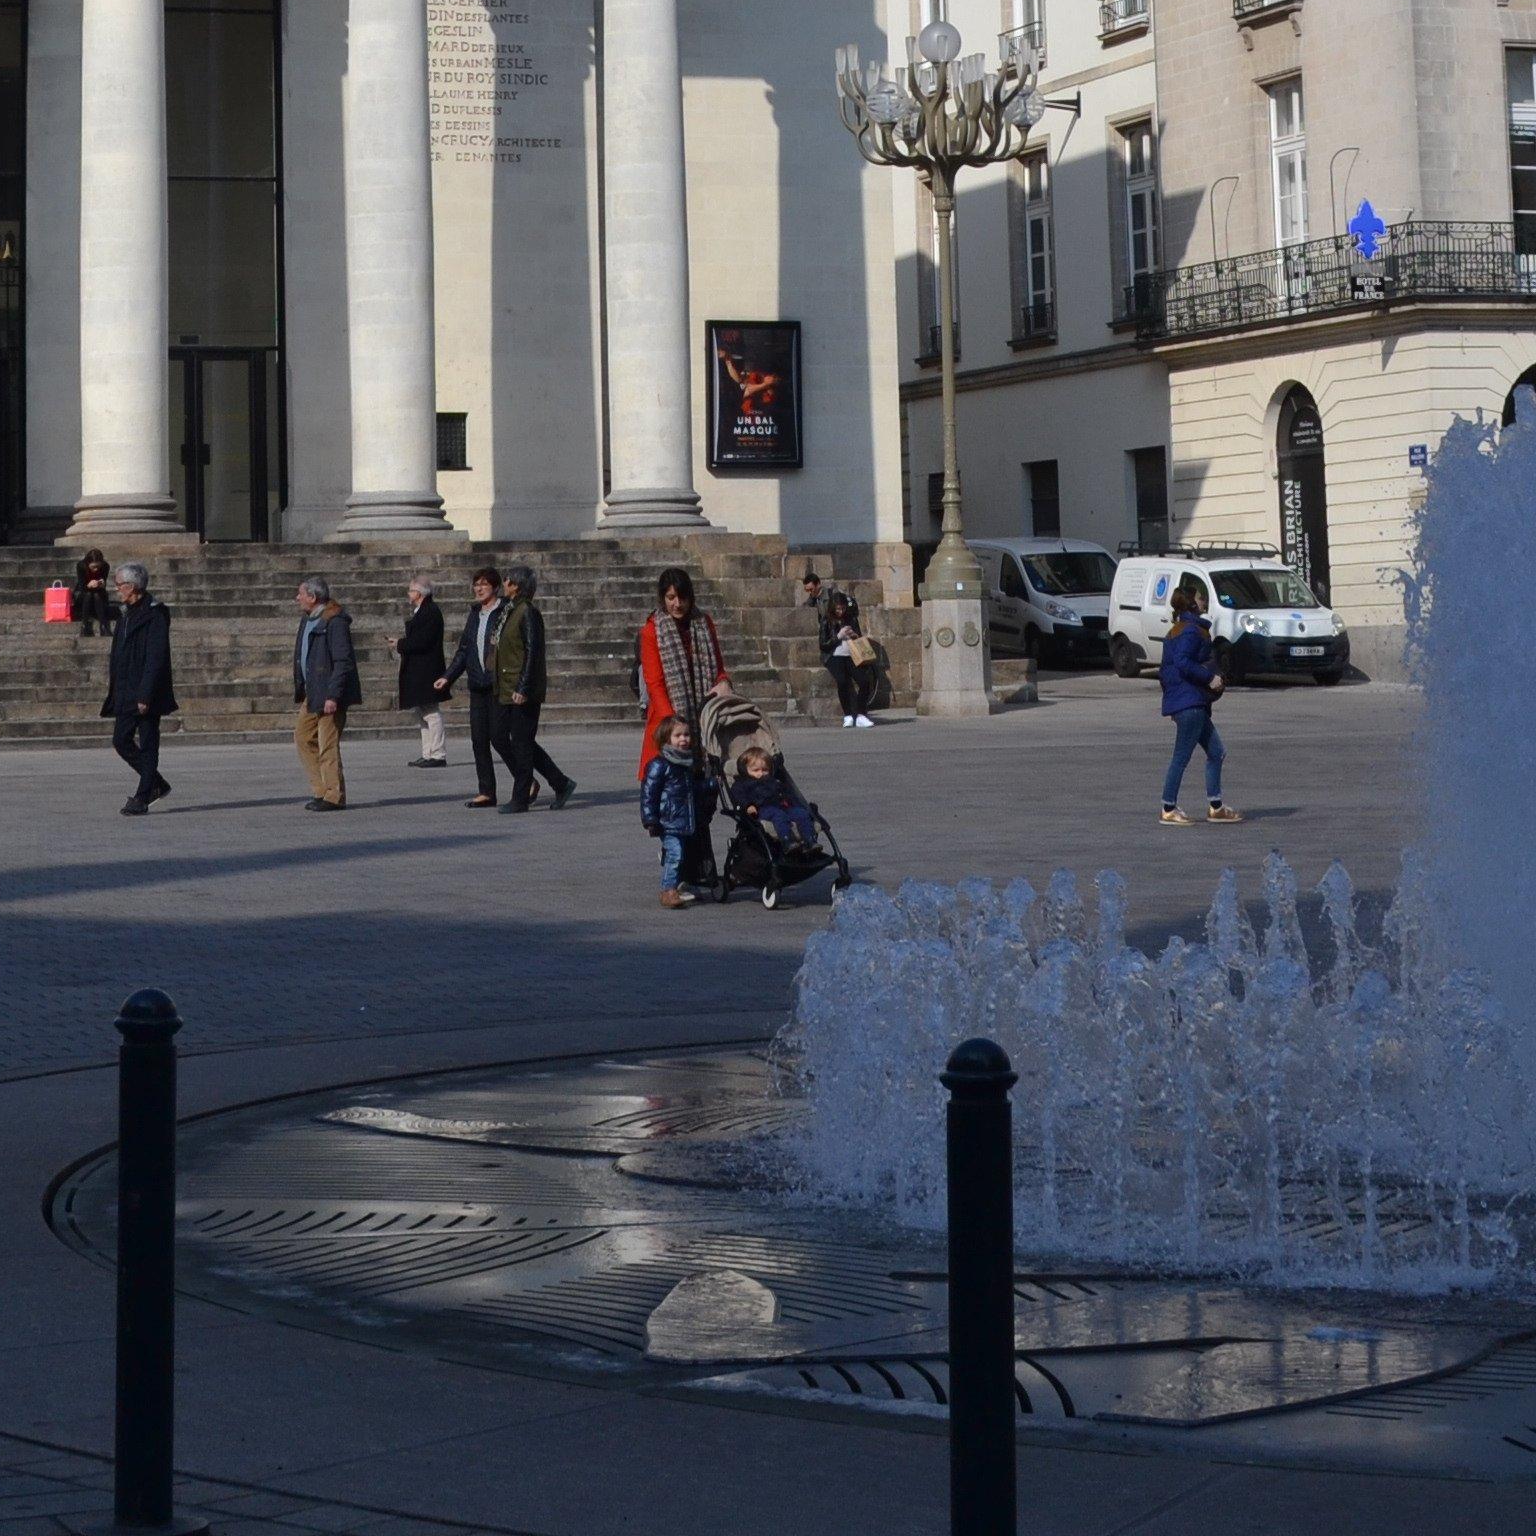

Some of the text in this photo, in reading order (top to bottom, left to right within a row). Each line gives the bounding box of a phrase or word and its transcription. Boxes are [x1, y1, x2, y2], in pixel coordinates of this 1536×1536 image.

[444, 72, 464, 83] DU
[467, 73, 495, 84] ROY
[500, 74, 549, 85] SINDIC
[477, 91, 519, 101] HENRY
[472, 153, 521, 163] NANTES
[737, 416, 774, 425] UN BAL
[1284, 479, 1296, 544] BRIAN
